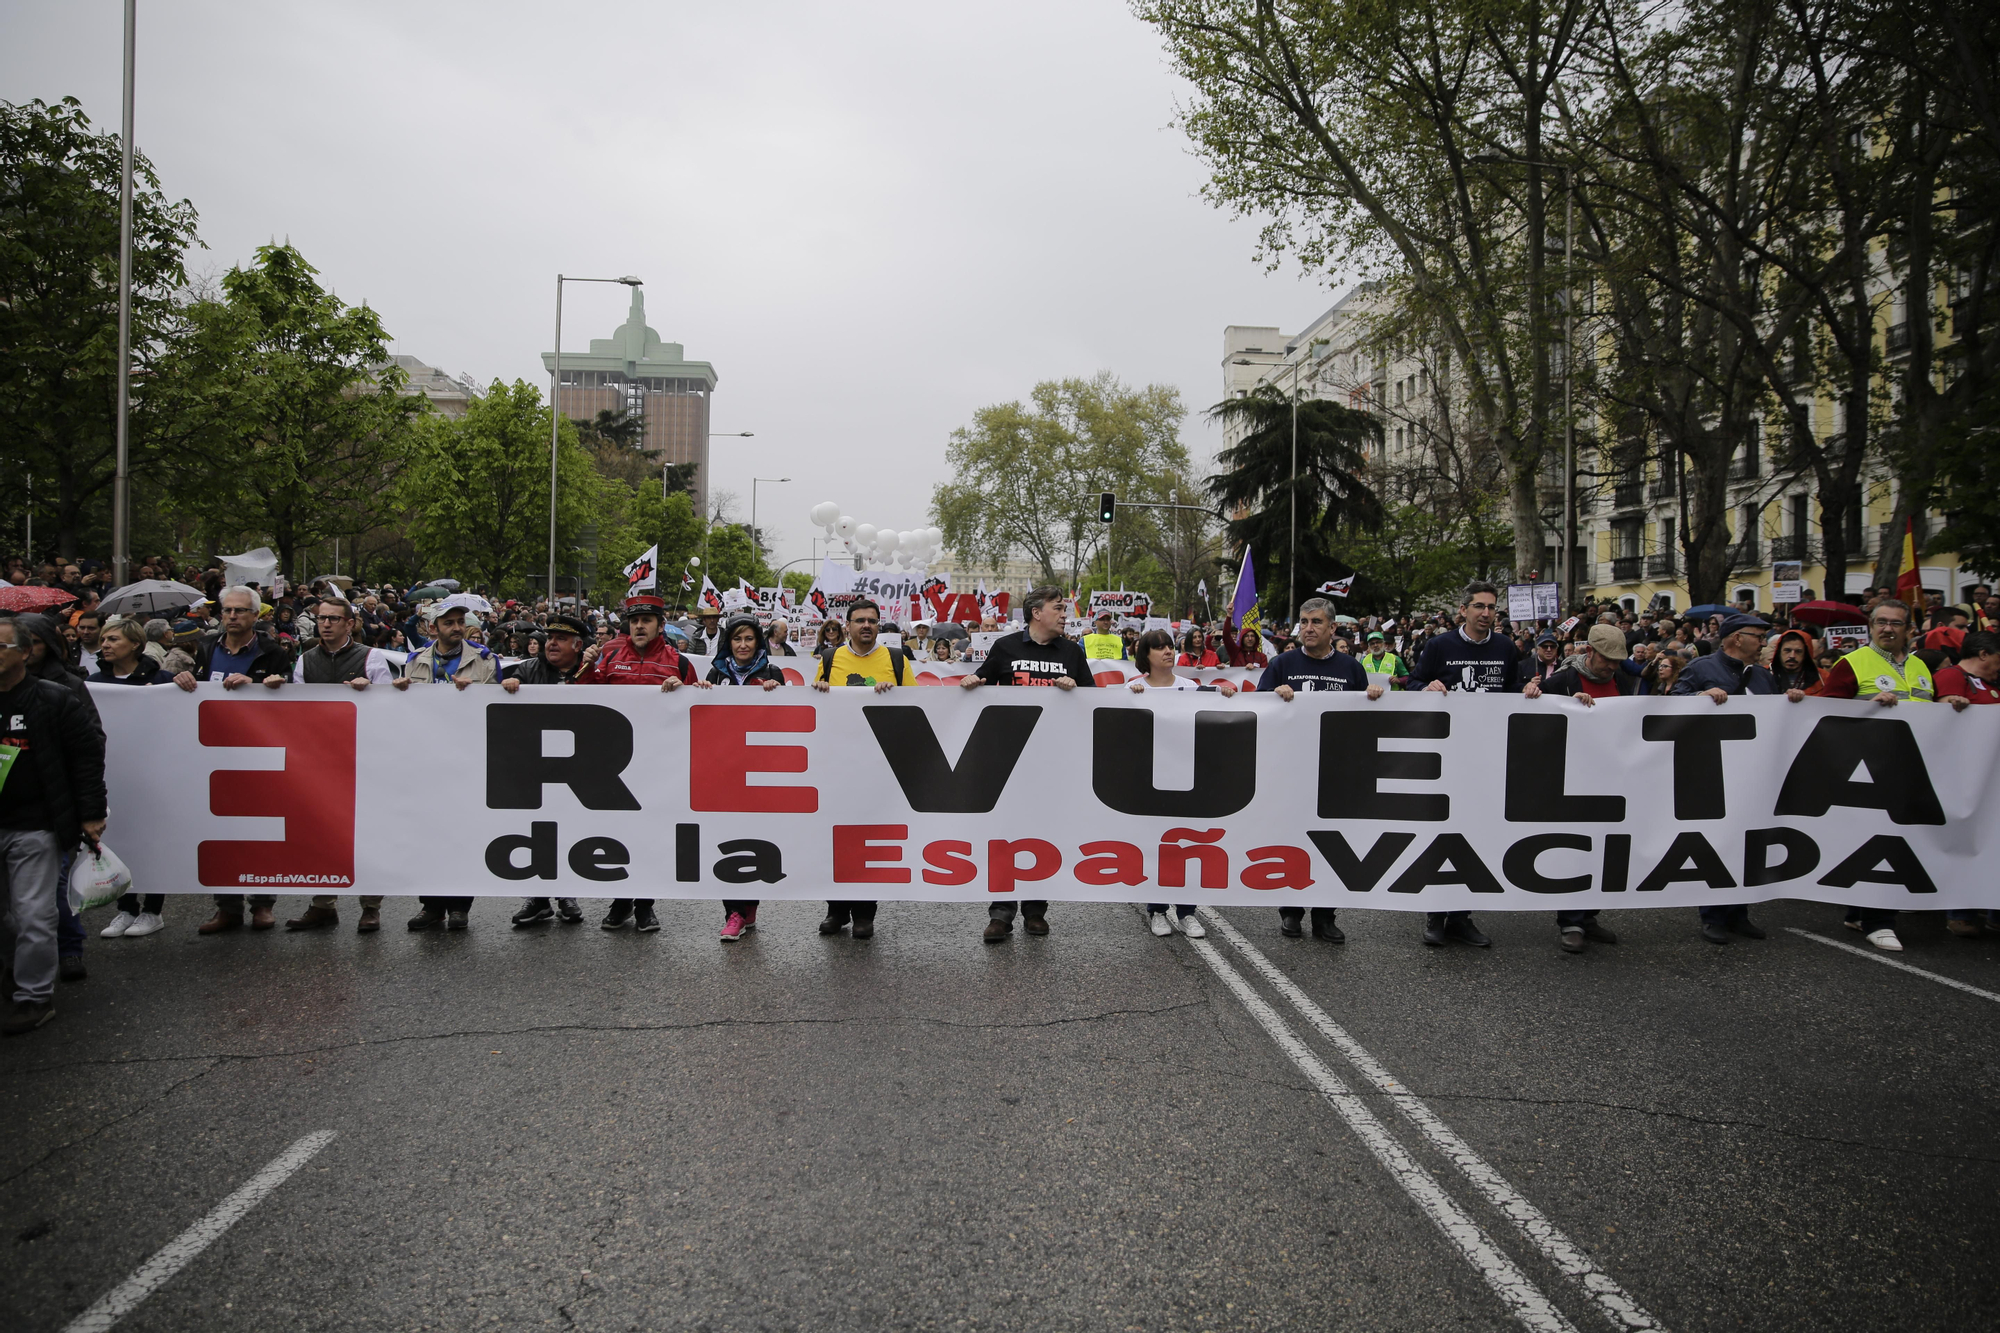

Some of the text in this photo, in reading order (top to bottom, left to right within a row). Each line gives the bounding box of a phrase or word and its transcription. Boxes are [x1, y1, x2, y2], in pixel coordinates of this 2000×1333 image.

[1099, 593, 1124, 601] SORIA
[1828, 627, 1867, 635] TERUEL
[1011, 659, 1067, 674] TERUEL
[486, 702, 1946, 825] REVUELTA
[485, 821, 630, 882] de
[676, 823, 787, 884] la
[238, 873, 351, 885] #EspañaVACIADA
